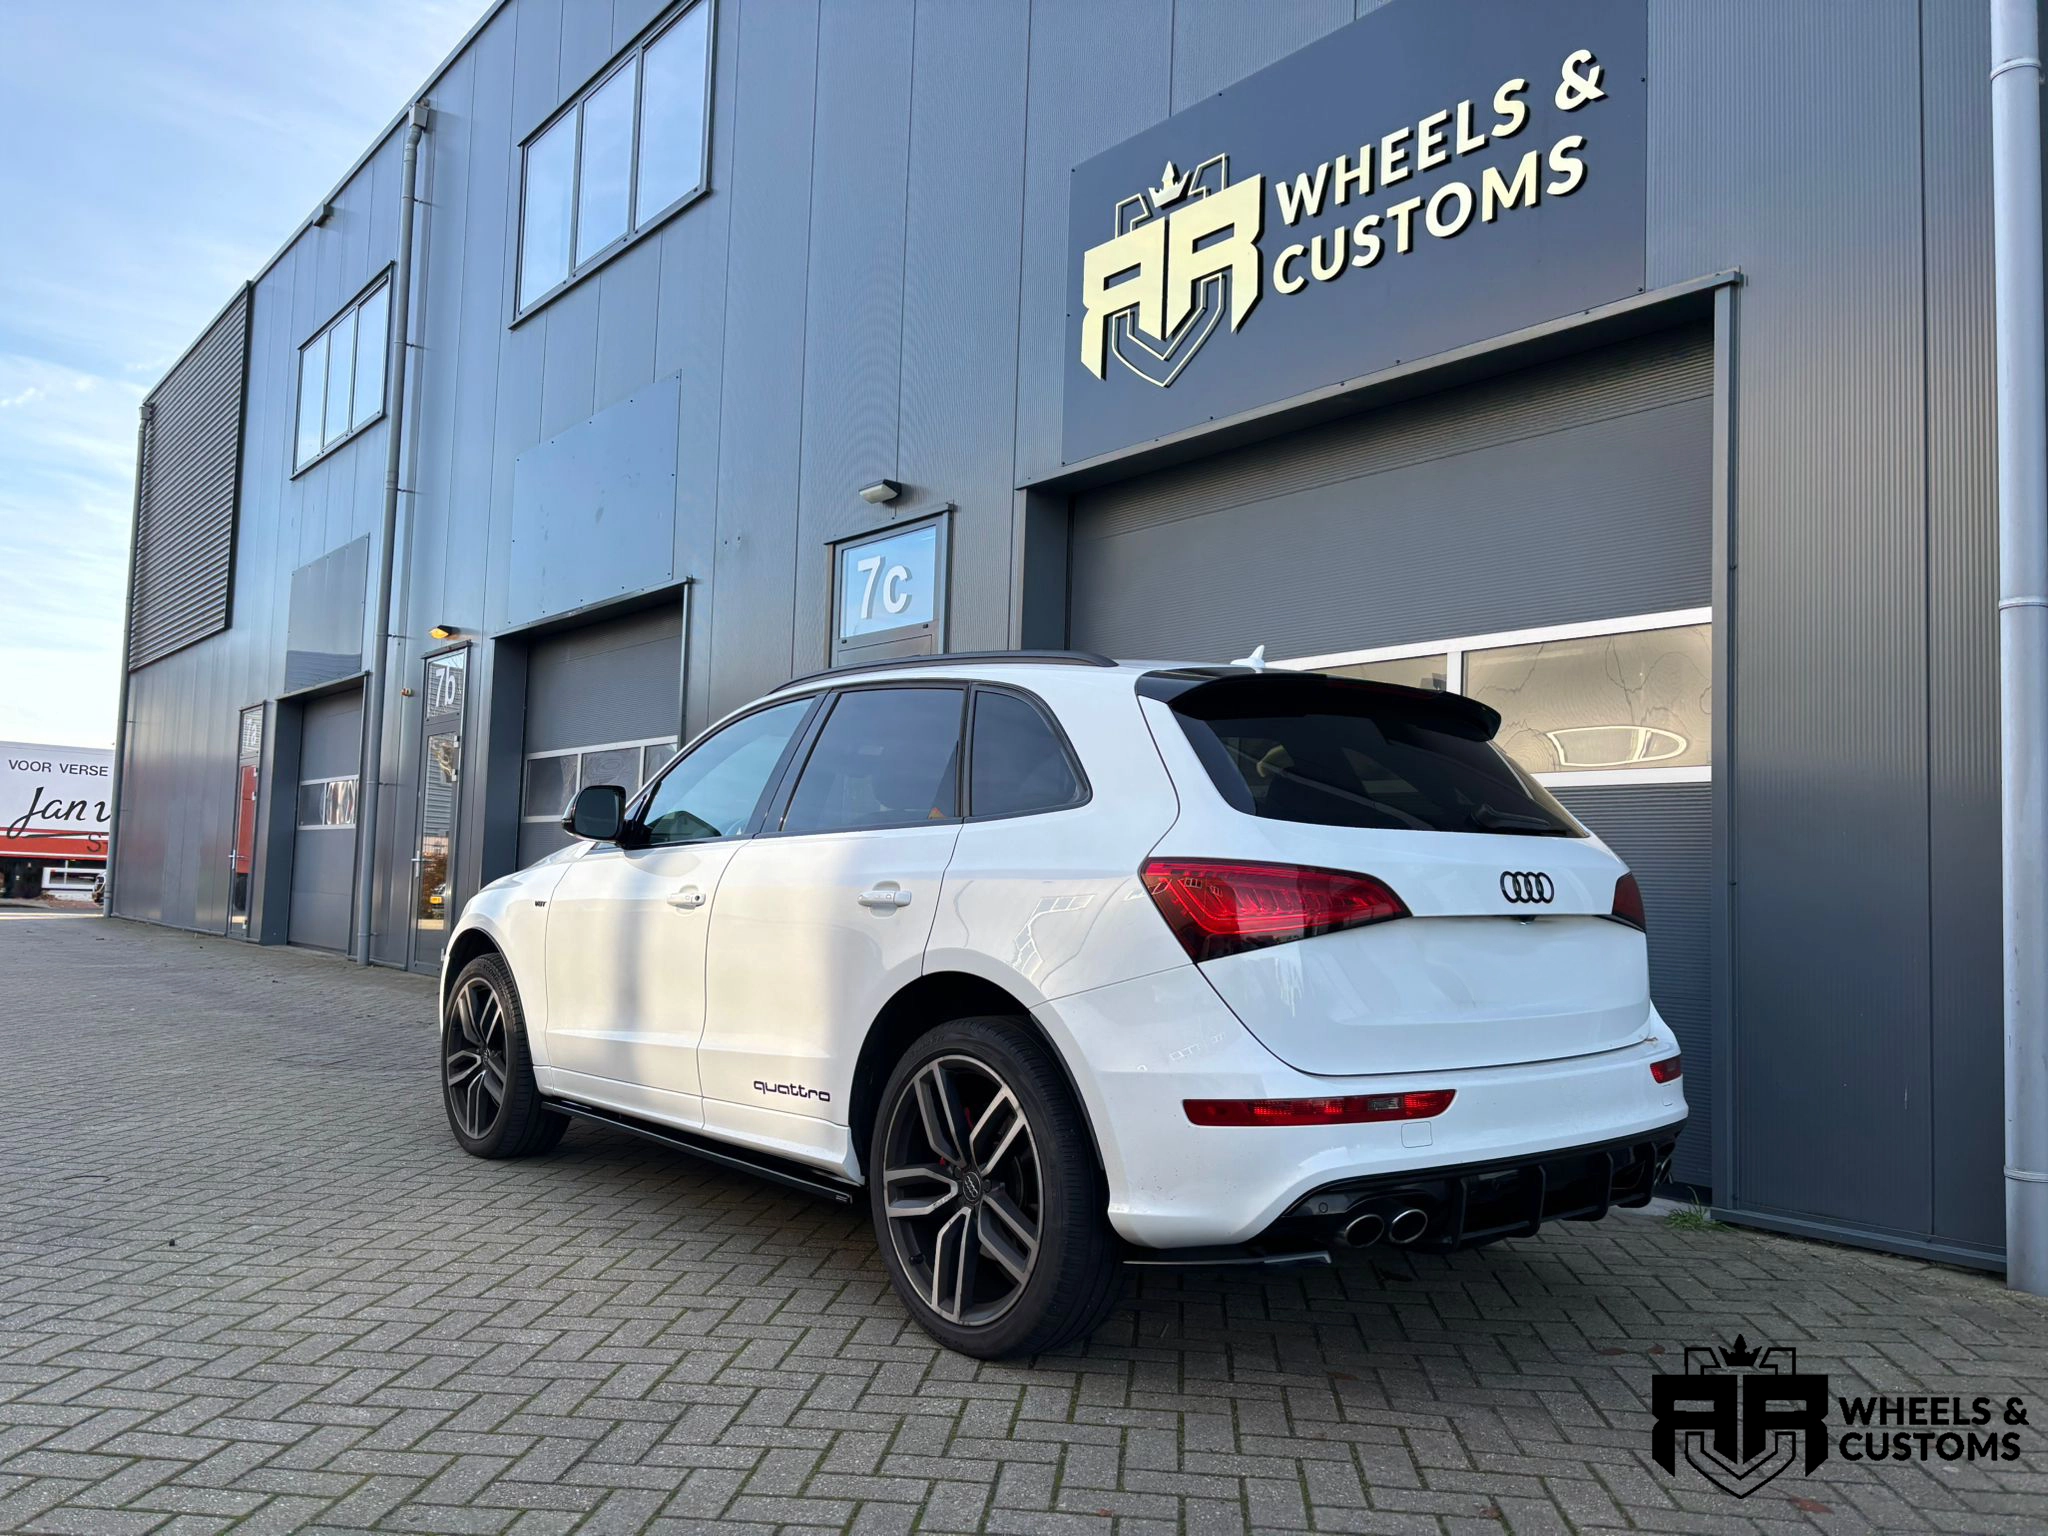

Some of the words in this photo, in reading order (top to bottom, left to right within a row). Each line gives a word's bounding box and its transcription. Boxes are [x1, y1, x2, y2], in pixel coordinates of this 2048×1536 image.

[1274, 77, 1526, 226] WHEELS
[1554, 48, 1606, 112] &
[1272, 135, 1584, 295] CUSTOMS
[434, 666, 456, 708] 7b
[8, 759, 52, 773] VOOR
[59, 762, 109, 777] VERSE
[6, 786, 88, 840] Jan
[753, 1080, 831, 1102] quattro
